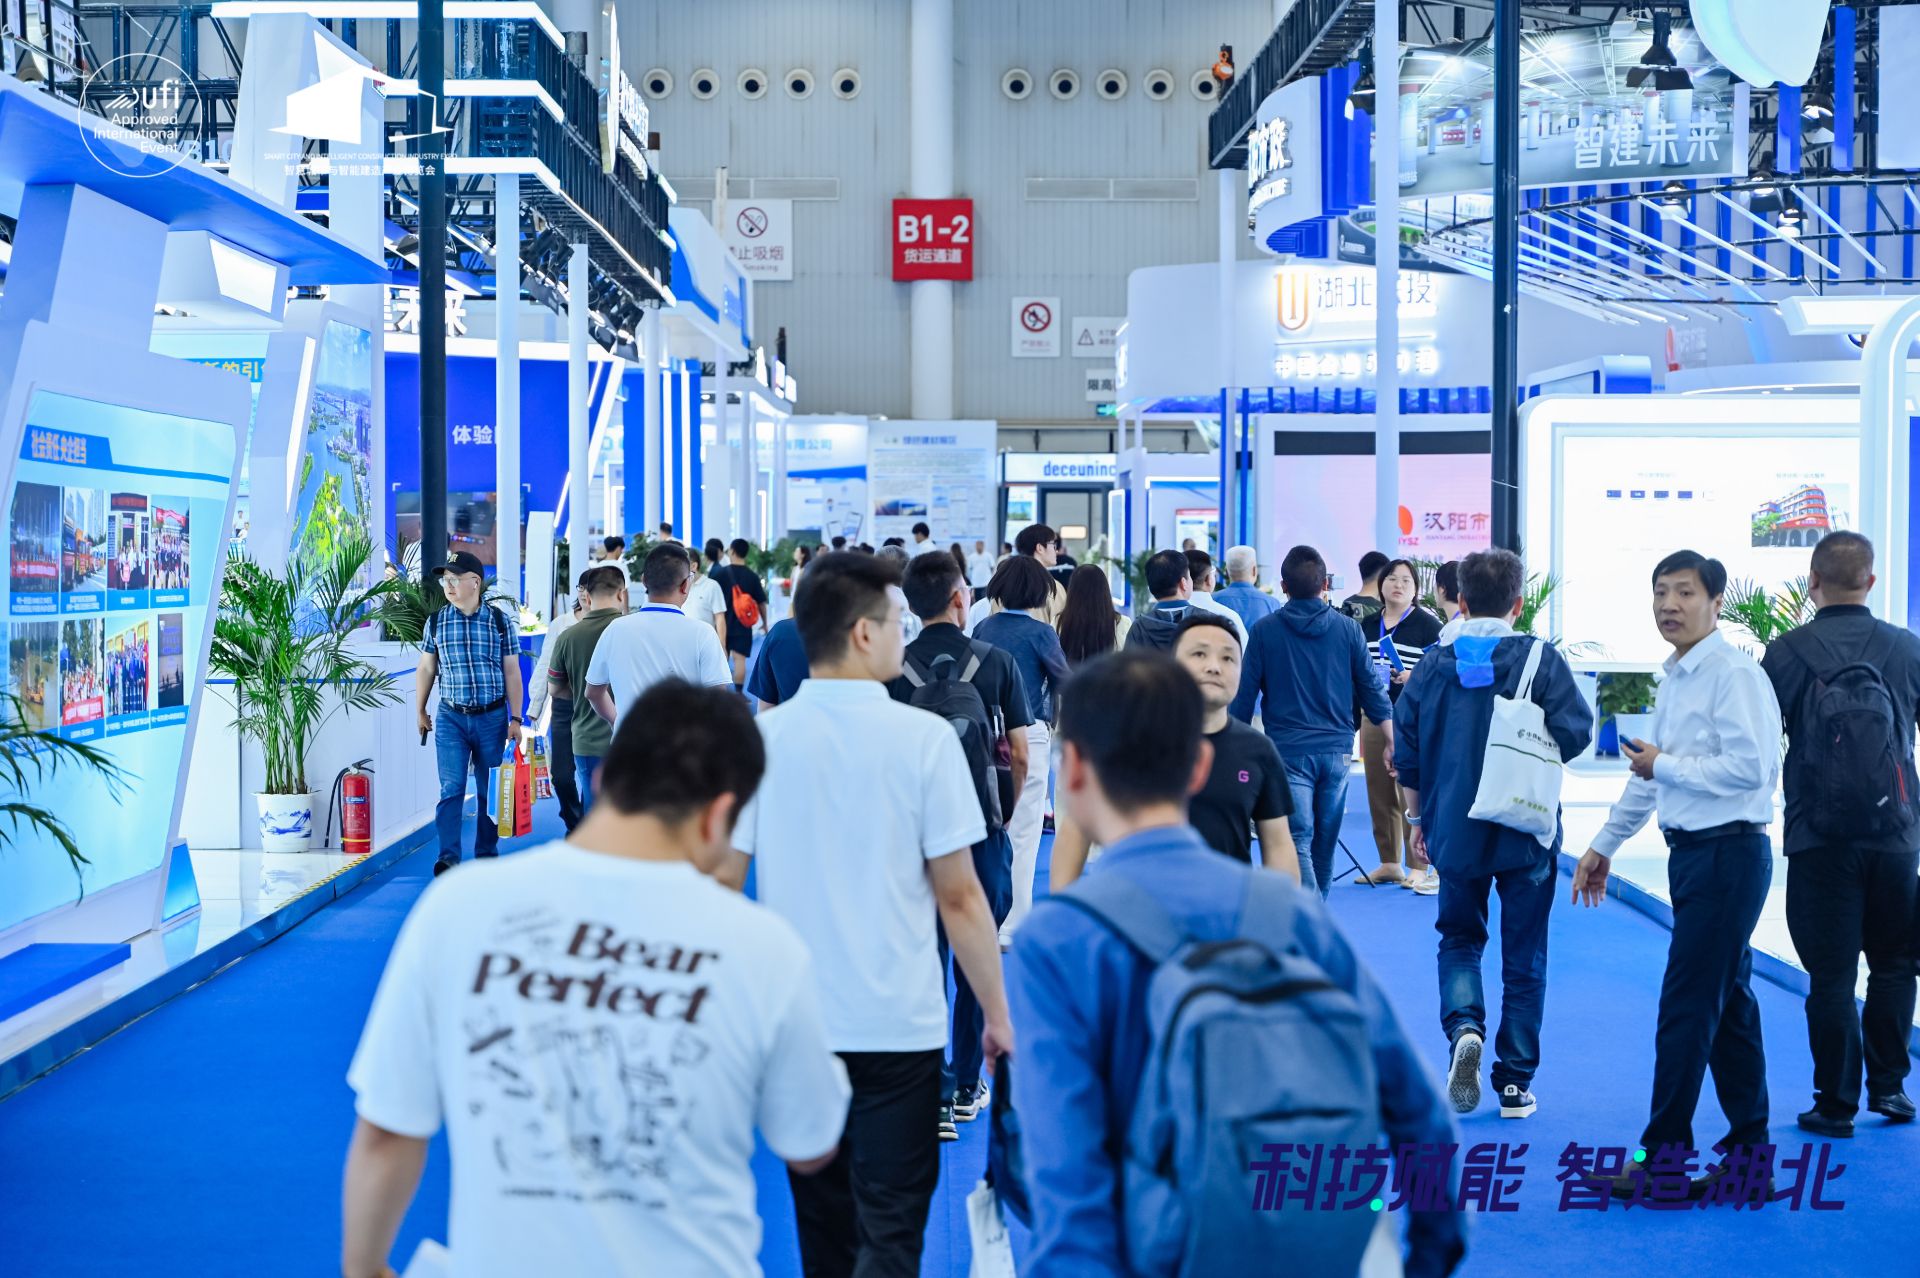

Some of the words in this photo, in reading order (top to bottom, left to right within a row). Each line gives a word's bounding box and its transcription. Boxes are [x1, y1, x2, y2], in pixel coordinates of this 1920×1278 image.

[1574, 119, 1720, 169] 智建未来
[898, 214, 970, 243] B1-2
[729, 245, 784, 261] 止吸烟
[904, 248, 963, 264] 货运通道
[1317, 271, 1432, 309] 湖北投
[452, 424, 497, 445] 体验
[566, 921, 721, 975] Bear
[471, 953, 709, 1025] Perfect
